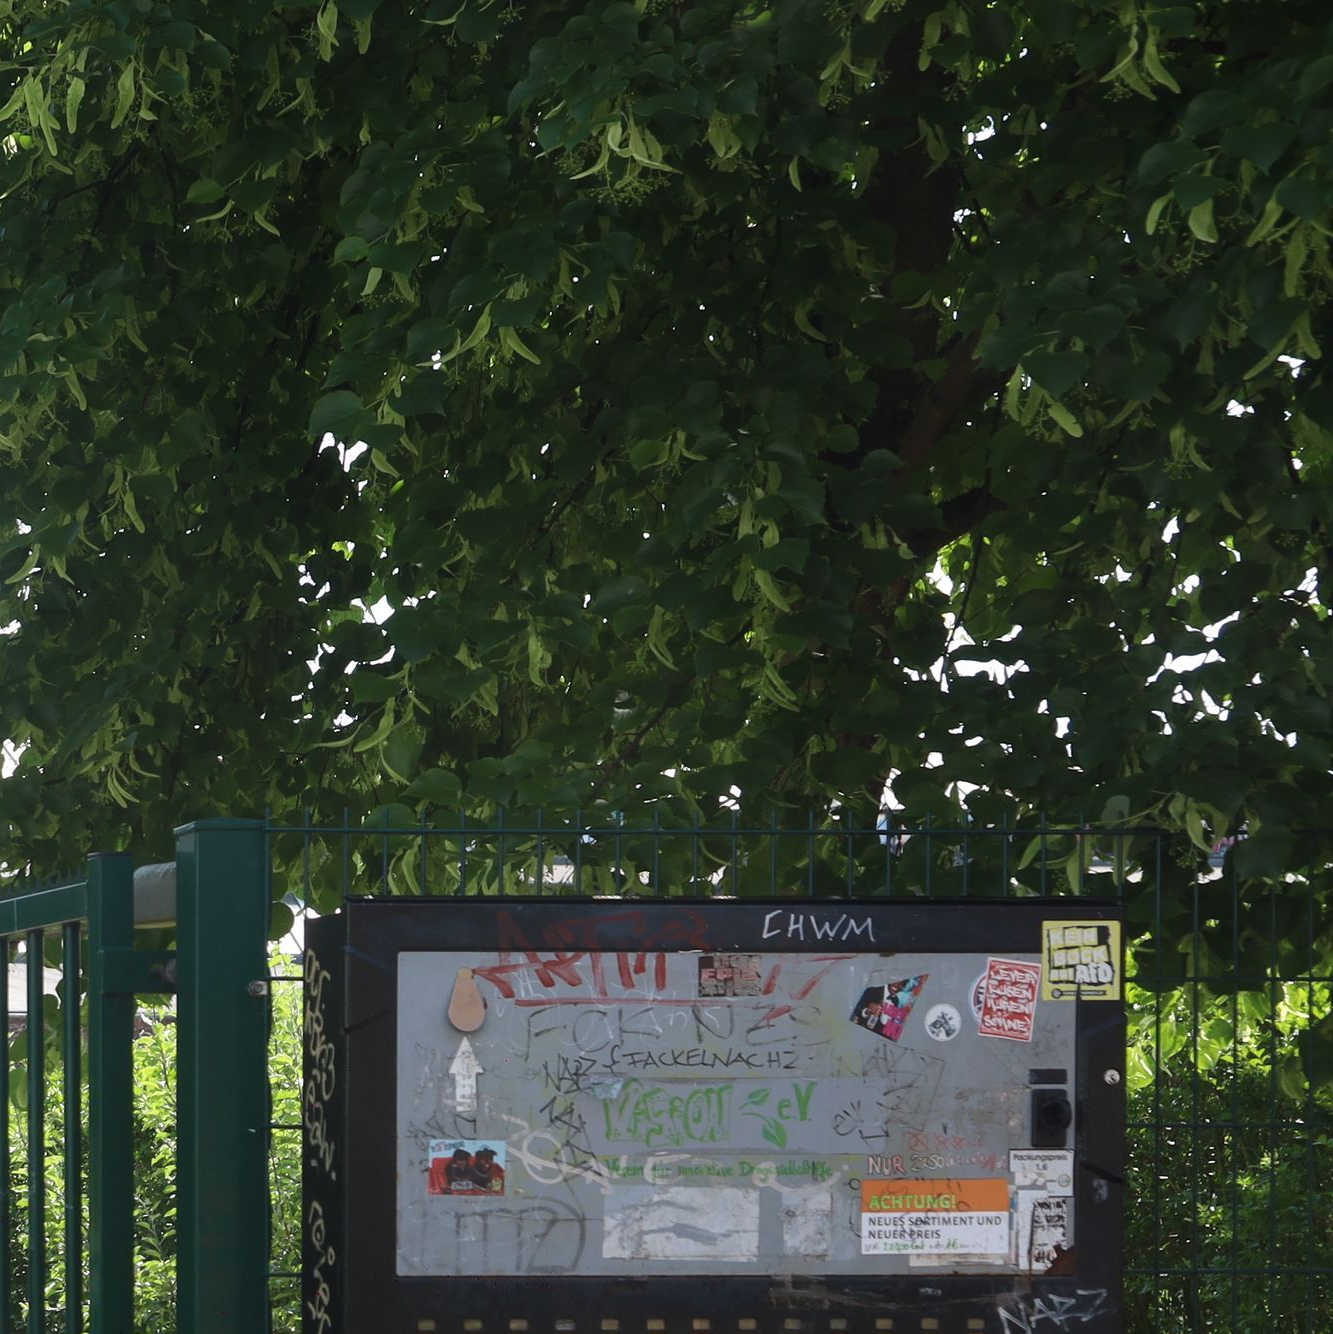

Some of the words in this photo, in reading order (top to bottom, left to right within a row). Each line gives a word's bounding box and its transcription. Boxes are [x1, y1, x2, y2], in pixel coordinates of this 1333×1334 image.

[869, 1194, 956, 1209] ACHTUNG!
[868, 1217, 905, 1227] NEUES
[908, 1216, 973, 1226] SORTIMENT
[977, 1216, 1002, 1226] UND
[868, 1229, 906, 1239] NEUER
[910, 1229, 941, 1239] PREIS
